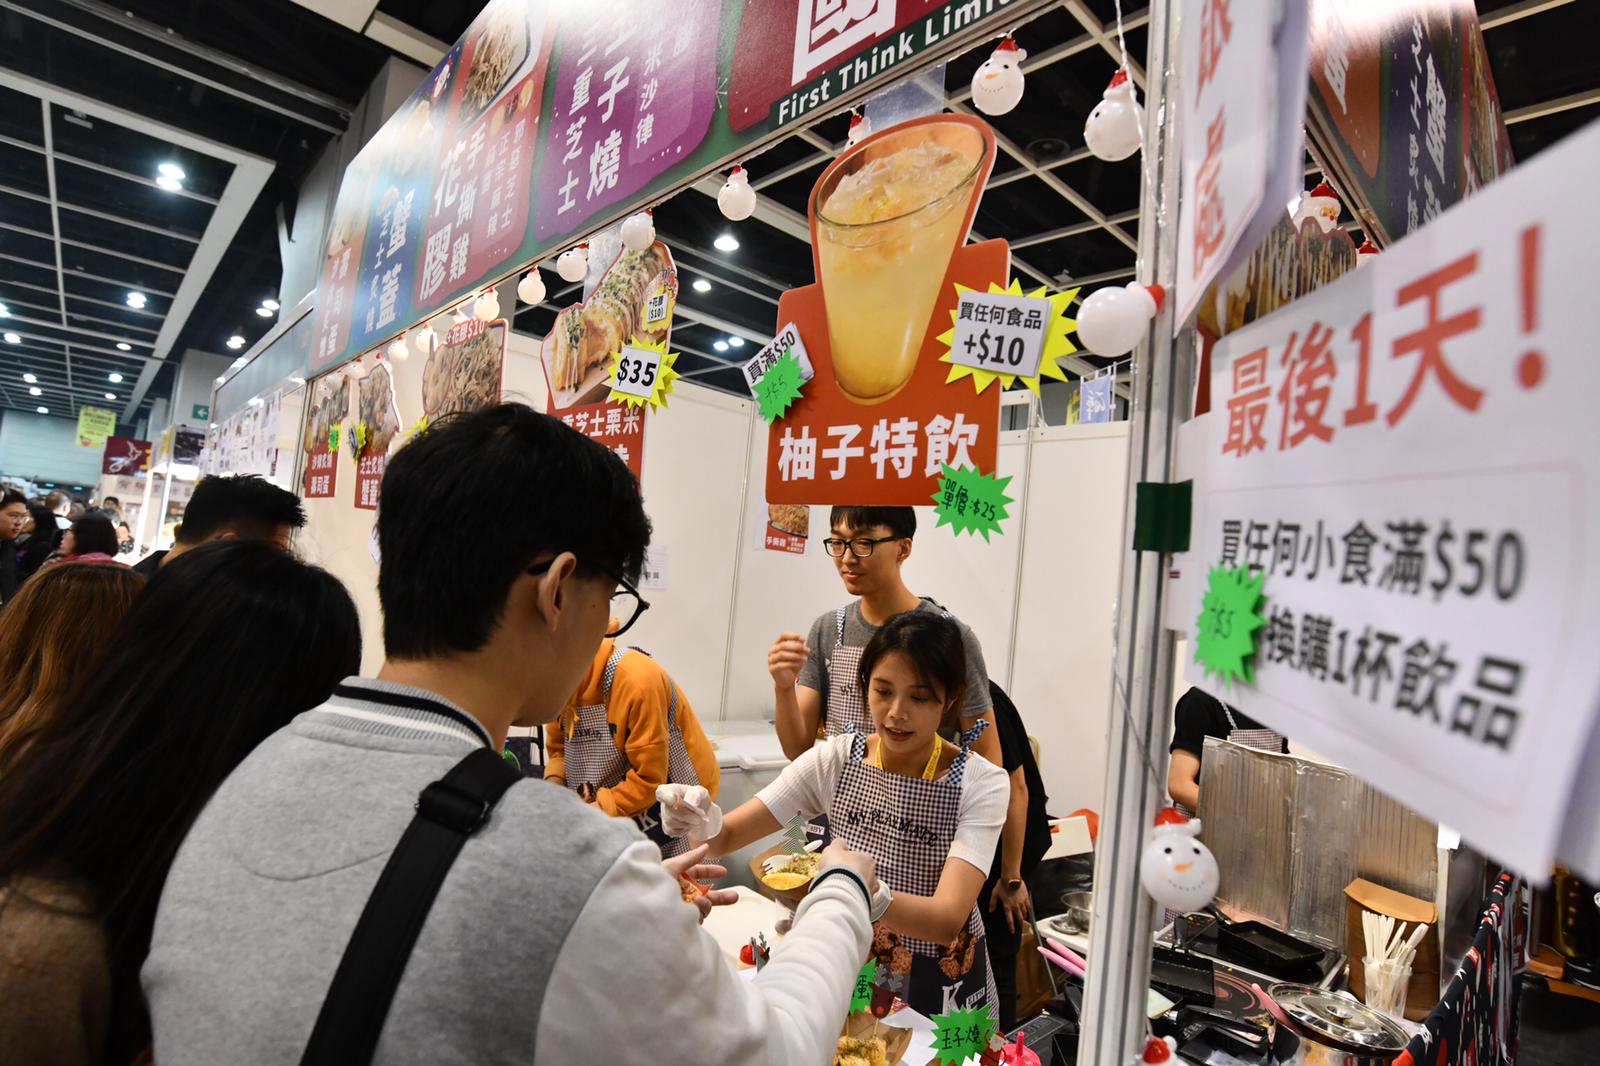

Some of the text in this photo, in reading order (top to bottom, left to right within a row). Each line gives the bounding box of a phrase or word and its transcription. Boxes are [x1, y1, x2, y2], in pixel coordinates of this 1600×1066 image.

[779, 0, 1012, 126] First Think Lim
[420, 139, 467, 301] 花膠
[449, 121, 486, 284] 手撕雞
[959, 301, 1042, 330] 買任何食品
[963, 328, 1025, 366] +$10
[1221, 221, 1547, 460] 最後1天!
[617, 355, 657, 387] $35
[747, 330, 796, 384] 買滿$50
[777, 412, 980, 482] 柚子特飲
[1220, 517, 1527, 603] 買任何小食滿$50
[1265, 602, 1525, 752] 換購1杯飲品
[851, 974, 872, 1002] 蛋
